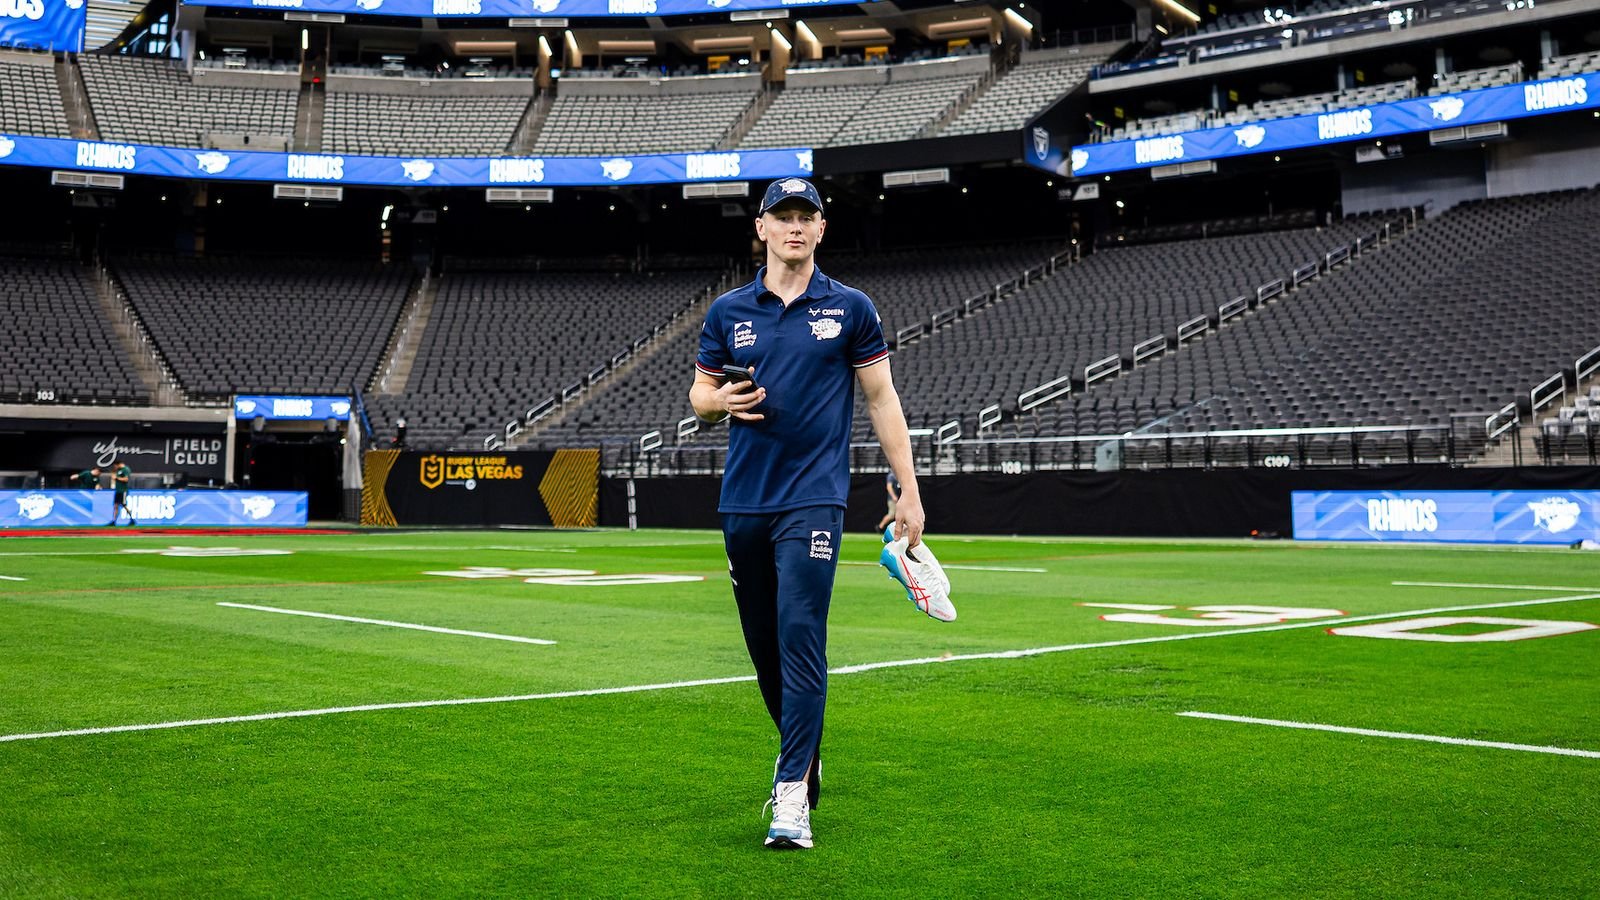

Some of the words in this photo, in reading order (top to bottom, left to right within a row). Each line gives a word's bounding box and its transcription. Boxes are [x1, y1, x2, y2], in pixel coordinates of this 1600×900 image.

[1524, 78, 1588, 112] RHINOS
[1318, 109, 1373, 139] RHINOS
[76, 142, 136, 169] RHINOS
[1135, 135, 1185, 163] RHINOS
[287, 154, 344, 179] RHINOS
[489, 159, 544, 182] RHINOS
[686, 153, 740, 178] RHINOS
[735, 328, 752, 337] Leeds
[37, 390, 55, 401] 103
[273, 399, 313, 417] RHINOS
[173, 439, 221, 451] FIELD
[174, 453, 218, 465] CLUB
[446, 456, 474, 465] RUGBY
[475, 456, 507, 465] LEAGUE
[1264, 455, 1290, 467] C109
[446, 465, 474, 479] LAS
[476, 465, 523, 479] VEGAS
[1367, 498, 1438, 532] RHINOS
[811, 539, 829, 547] Leeds
[810, 551, 831, 561] Society
